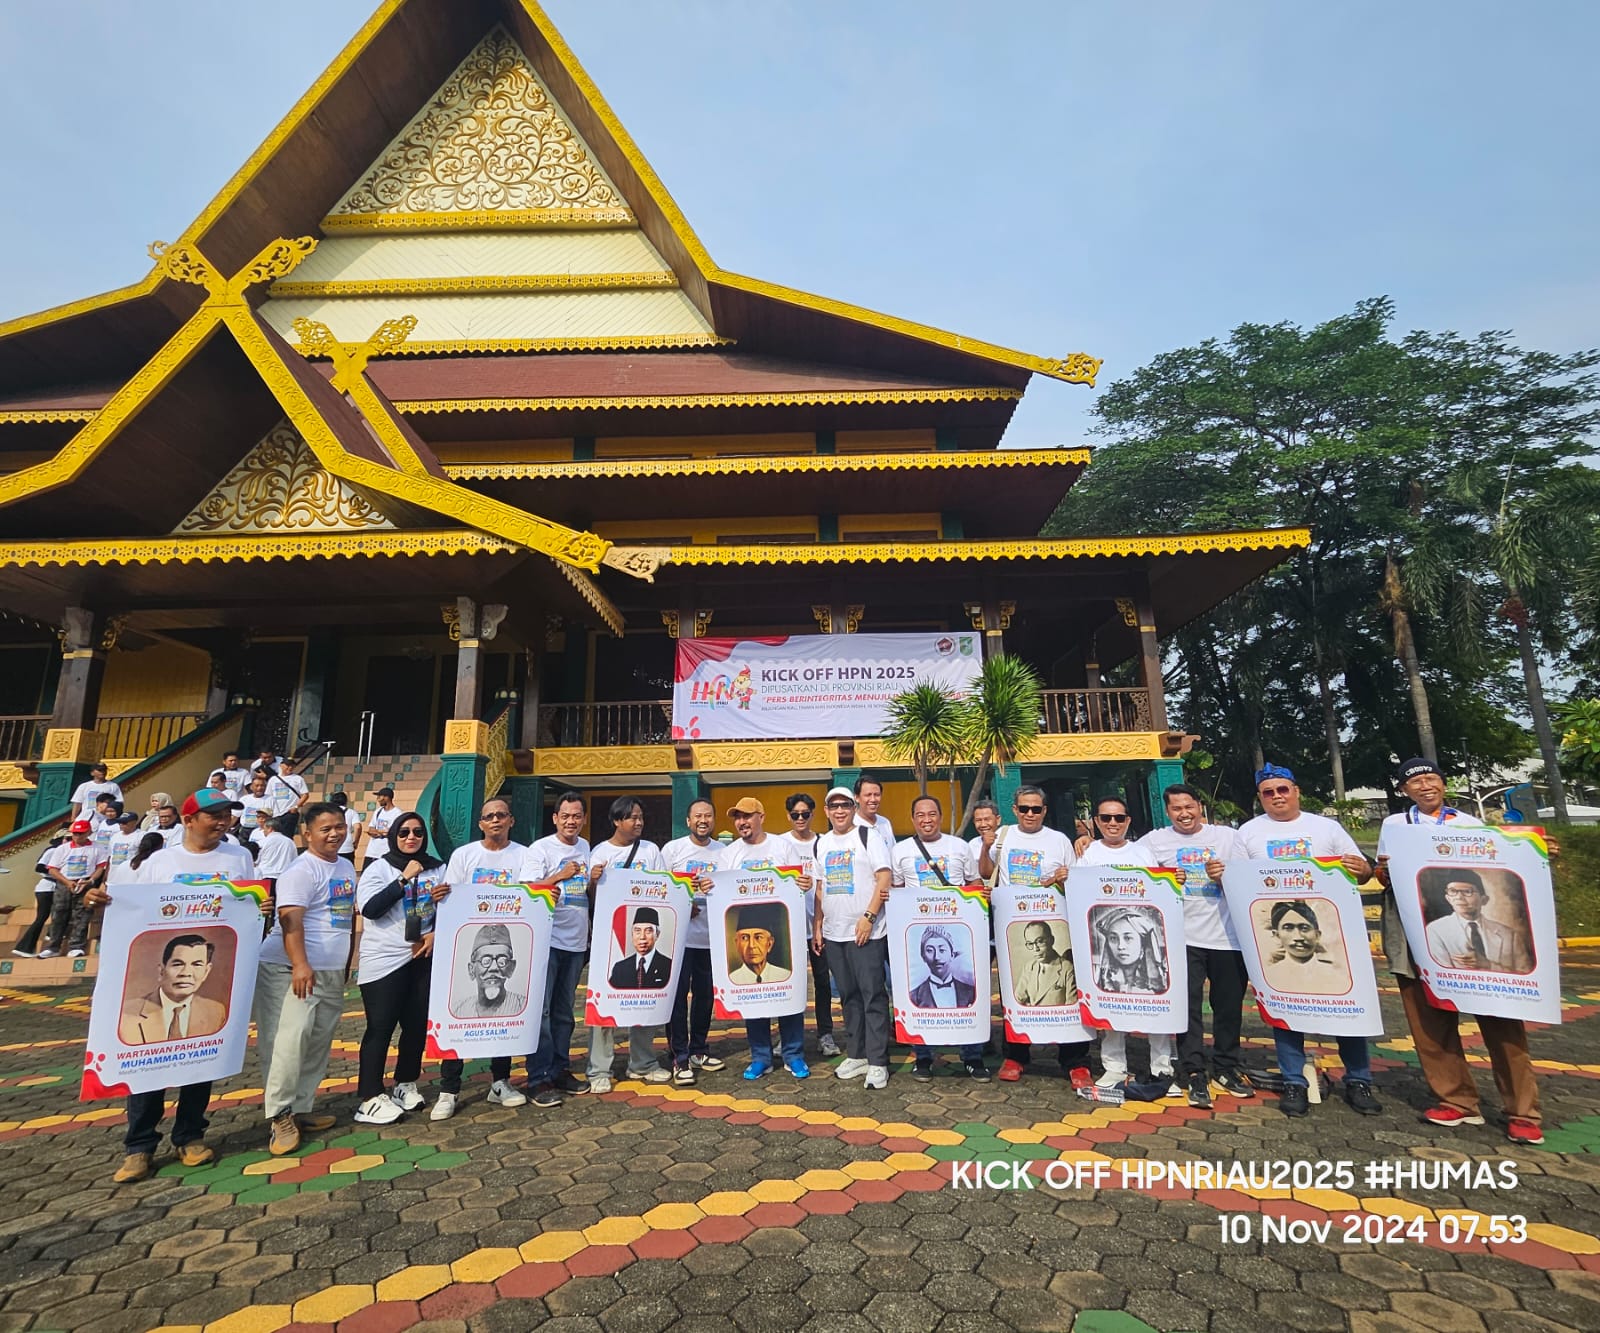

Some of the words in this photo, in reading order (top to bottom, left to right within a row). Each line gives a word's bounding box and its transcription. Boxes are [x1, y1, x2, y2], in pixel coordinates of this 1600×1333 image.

[761, 669, 799, 682] KICK
[803, 668, 834, 681] OFF
[838, 667, 872, 680] HPN
[876, 666, 915, 679] 2025
[761, 683, 818, 694] DIPUSATKAN
[832, 682, 875, 692] PROVINSI
[877, 682, 898, 691] RIAU
[789, 695, 851, 703] BERINTEGRITAS
[160, 893, 215, 902] SUKSESKAN
[1435, 971, 1485, 981] WARTAWAN
[1486, 977, 1538, 988] PAHLAWAN
[763, 985, 793, 993] PAHLAWAN
[1446, 981, 1477, 990] HAJAR
[1478, 983, 1540, 997] DEWANTARA
[1097, 996, 1134, 1004] WARTAWAN
[1270, 994, 1310, 1005] WARTAWAN
[1311, 998, 1356, 1006] PAHLAWAN
[1266, 1000, 1286, 1010] TJIPTO
[1287, 1003, 1365, 1014] MANGOENKOESOEMO
[448, 1022, 487, 1030] WARTAWAN
[488, 1020, 525, 1028] PAHLAWAN
[485, 1028, 508, 1036] SALIM
[116, 1046, 173, 1060] WARTAWAN
[174, 1037, 224, 1052] PAHLAWAN
[120, 1052, 186, 1069] MUHAMMAD
[187, 1047, 218, 1059] YAMIN
